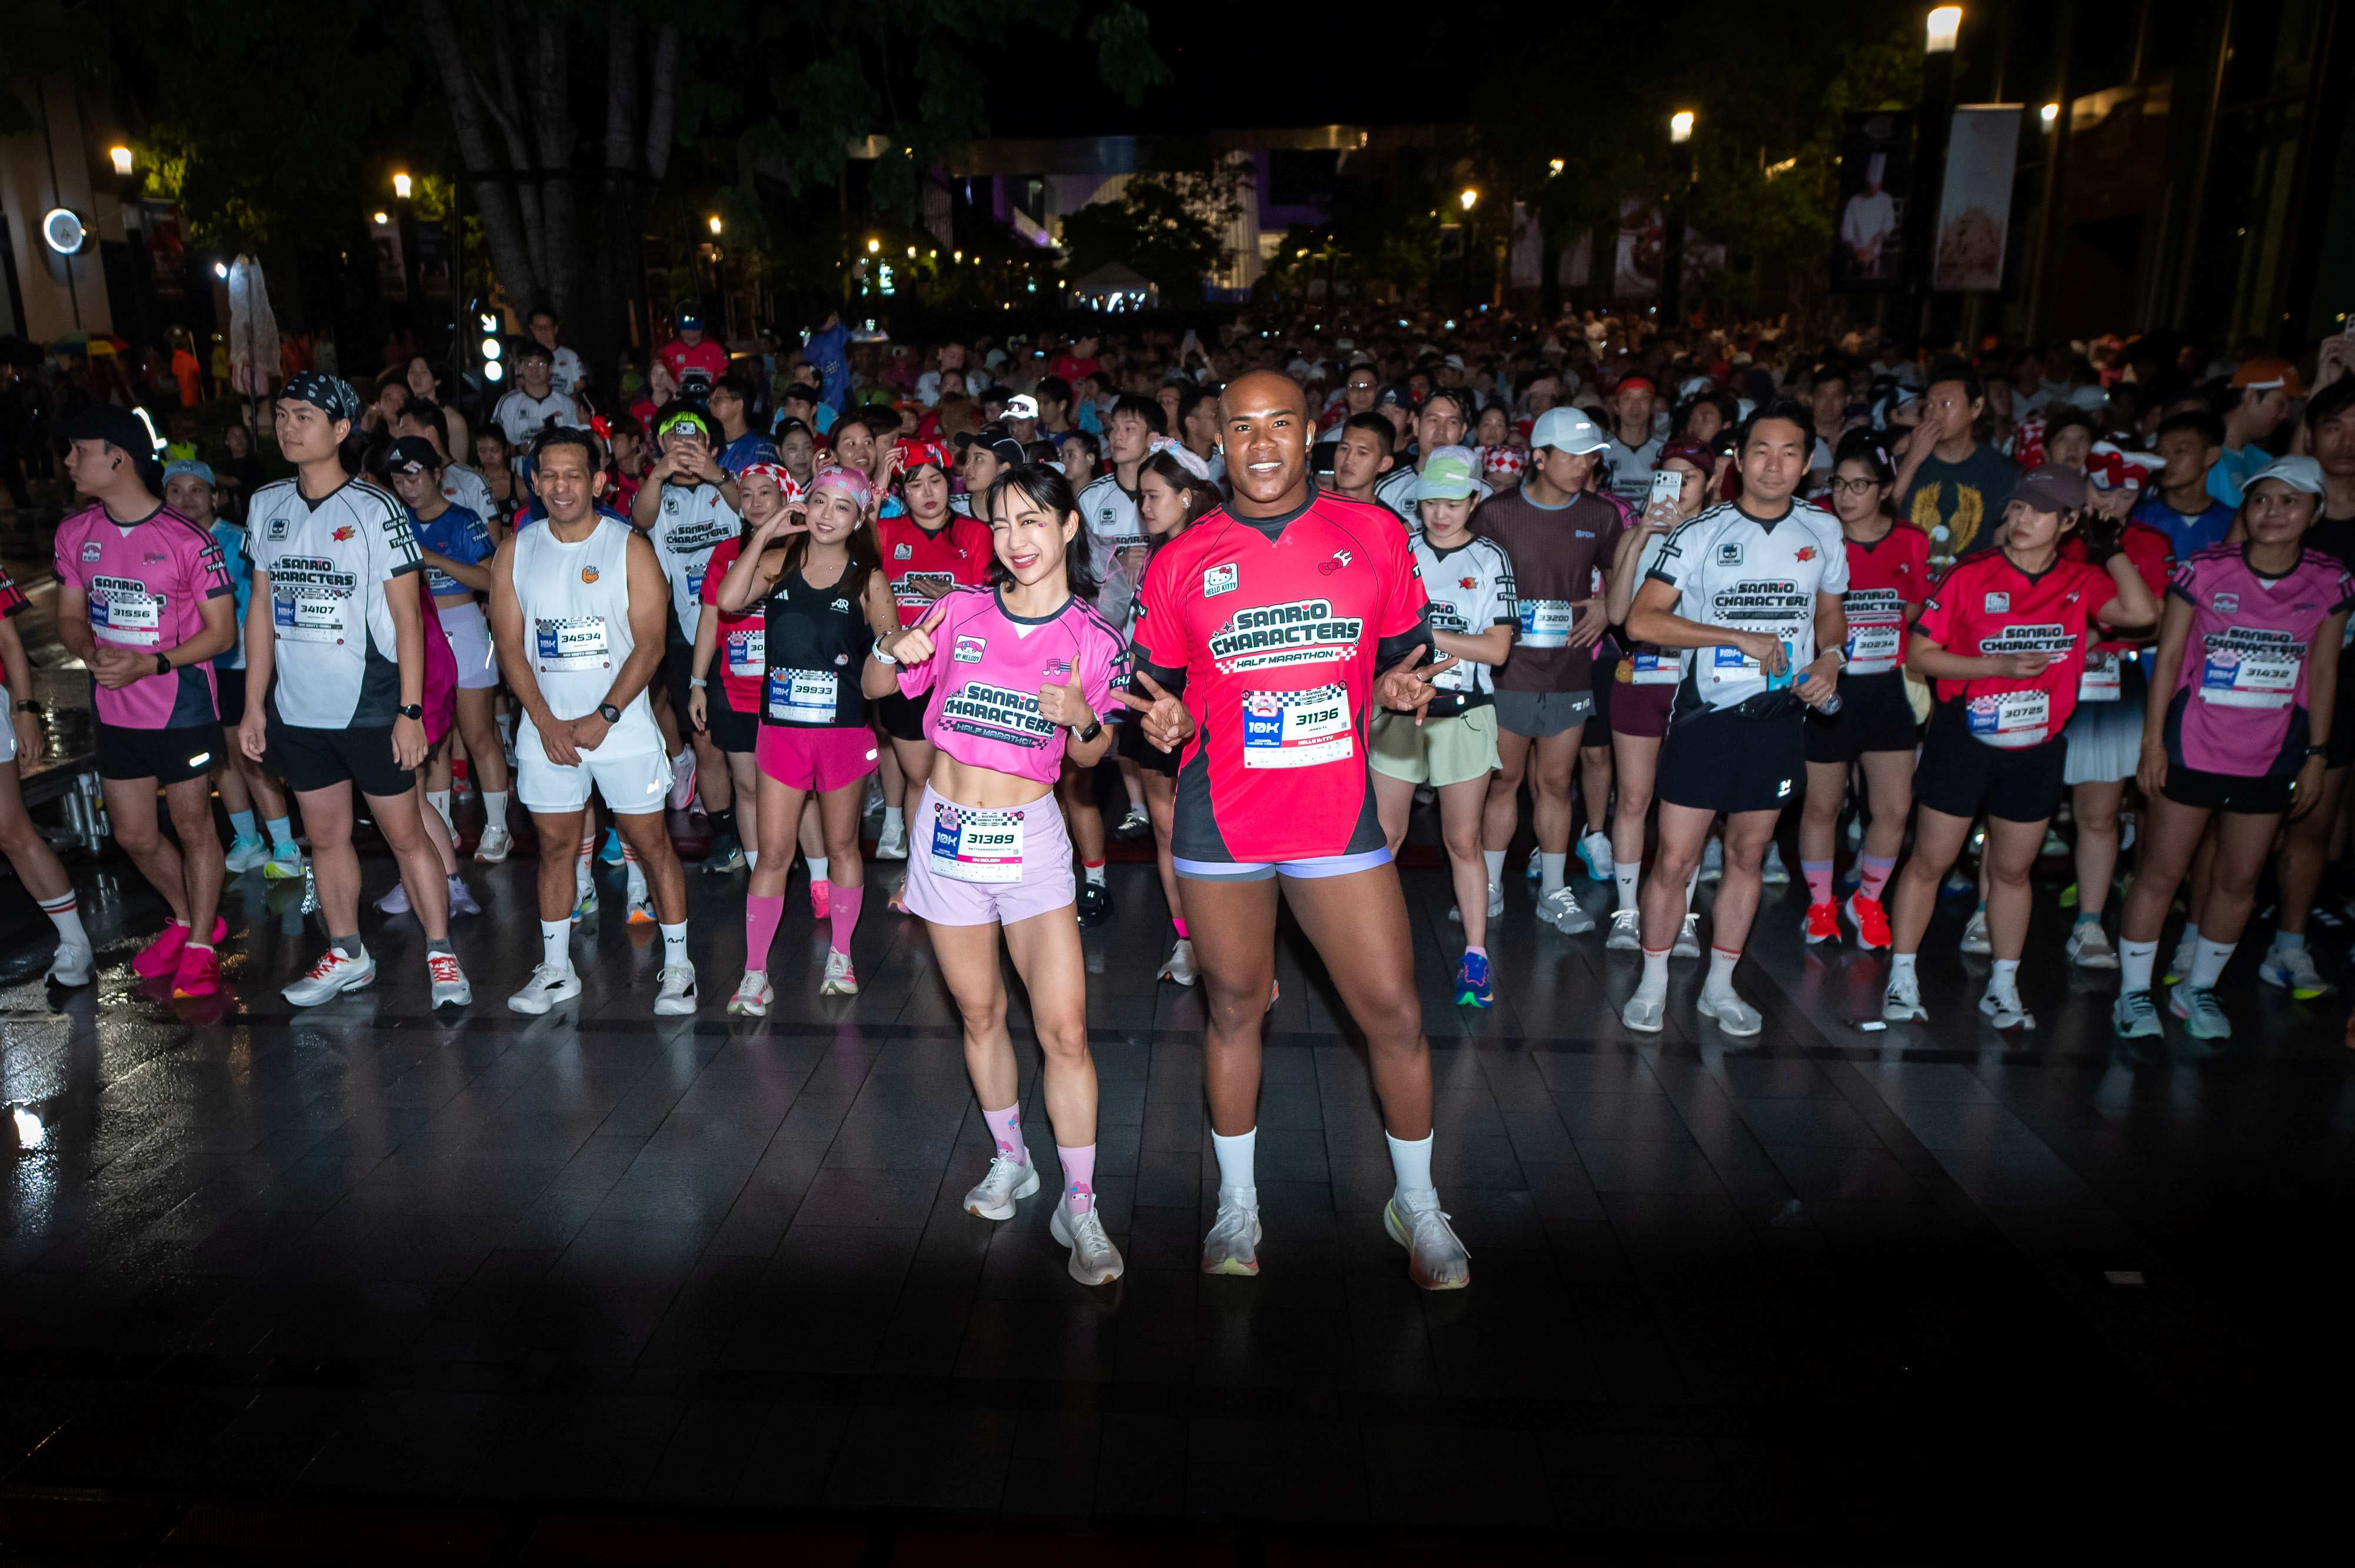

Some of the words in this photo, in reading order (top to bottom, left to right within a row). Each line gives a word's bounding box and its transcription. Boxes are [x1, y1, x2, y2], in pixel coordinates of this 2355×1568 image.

[1206, 586, 1220, 596] HELLO
[1222, 582, 1236, 592] KITTY
[113, 609, 150, 618] 31556
[300, 605, 335, 614] 34107
[561, 632, 601, 643] 34534
[1211, 622, 1360, 656] CHARACTERS
[540, 639, 556, 648] 10K
[962, 654, 980, 662] MELODY
[1236, 657, 1267, 669] HALF
[1268, 650, 1334, 664] MARATHON
[2245, 668, 2290, 679] 31432
[772, 686, 790, 696] 10K
[795, 685, 832, 695] 39933
[1296, 707, 1338, 726] 31136
[2004, 706, 2044, 718] 30725
[957, 723, 982, 733] HALF
[1248, 722, 1280, 733] 10K
[937, 832, 958, 846] 10K
[967, 833, 1014, 844] 31389
